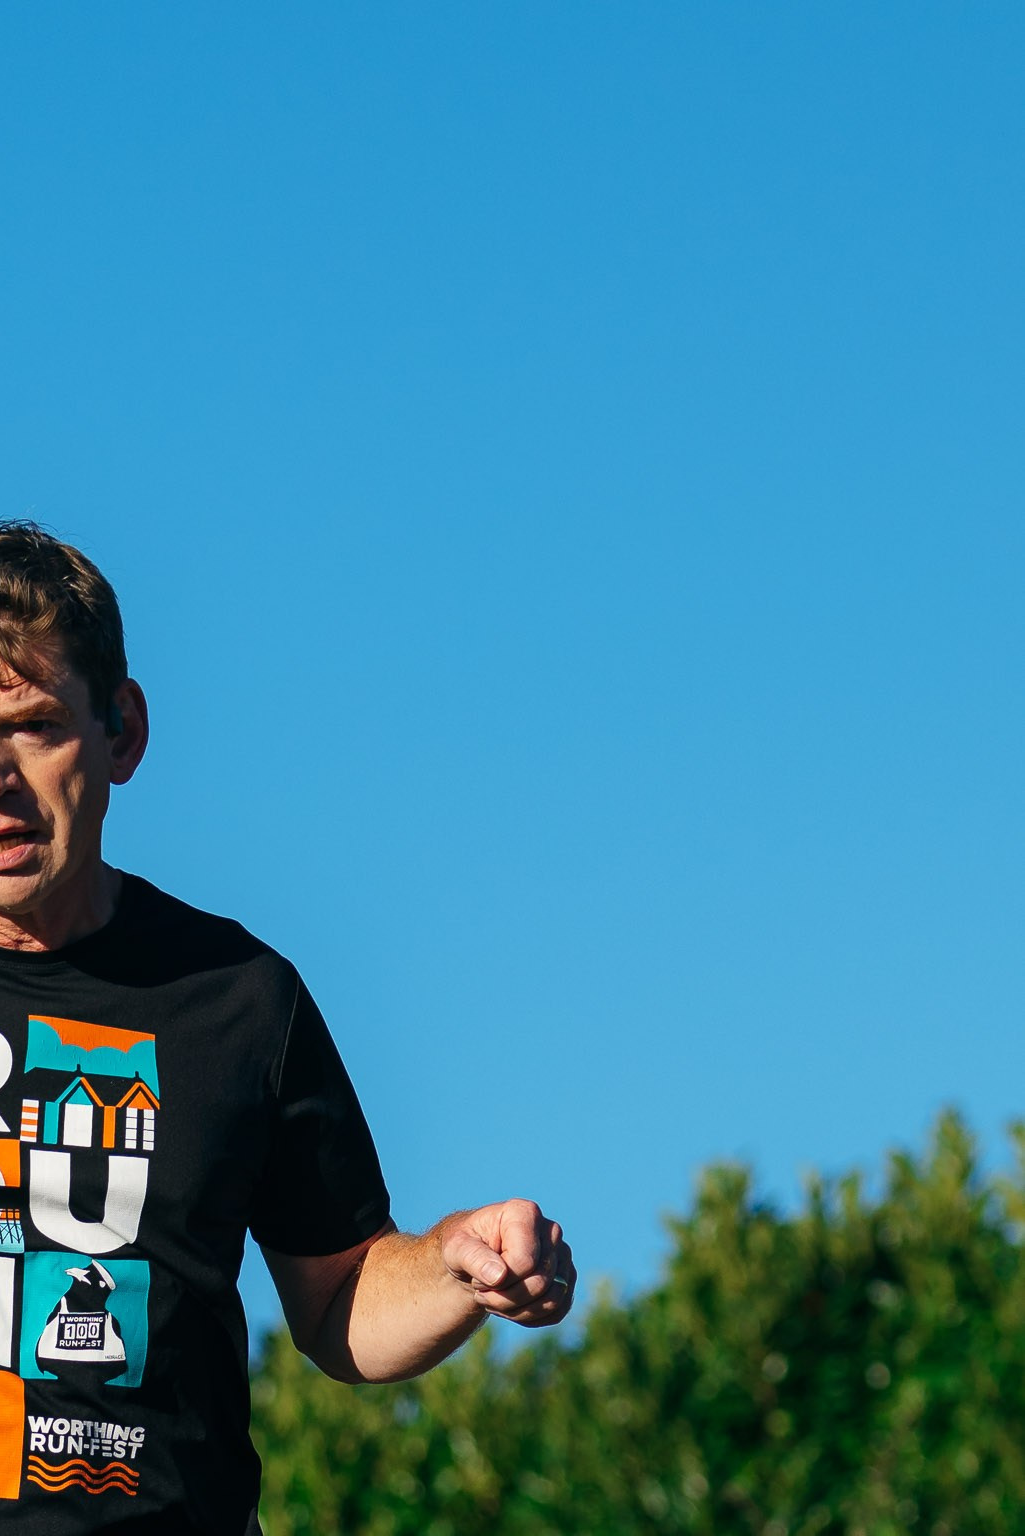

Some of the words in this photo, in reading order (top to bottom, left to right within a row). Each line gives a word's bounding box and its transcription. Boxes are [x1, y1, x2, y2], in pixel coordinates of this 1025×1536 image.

[30, 1149, 149, 1254] U
[66, 1324, 98, 1338] 100
[27, 1415, 145, 1443] WORTHING
[30, 1432, 143, 1459] RUN-FEST
